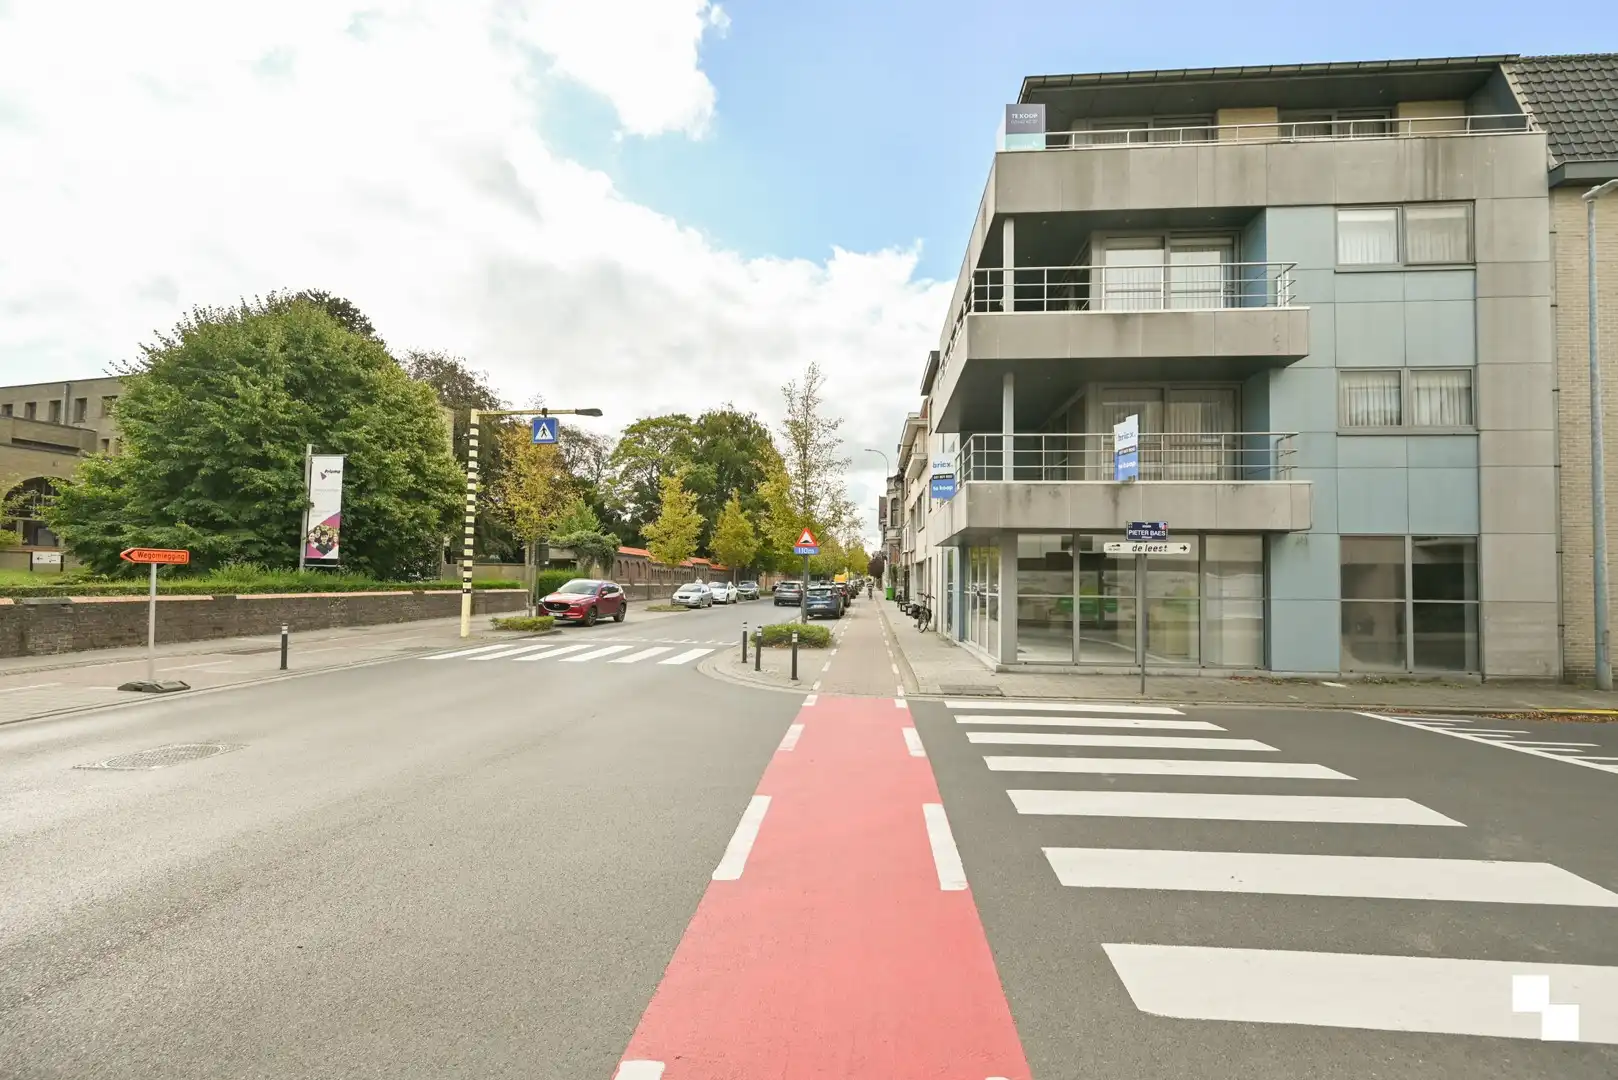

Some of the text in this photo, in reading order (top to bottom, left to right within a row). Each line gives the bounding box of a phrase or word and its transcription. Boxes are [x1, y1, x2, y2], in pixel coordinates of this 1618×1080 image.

[1131, 544, 1143, 552] de
[1144, 544, 1168, 553] leest
[137, 551, 185, 560] Wegomlegging
